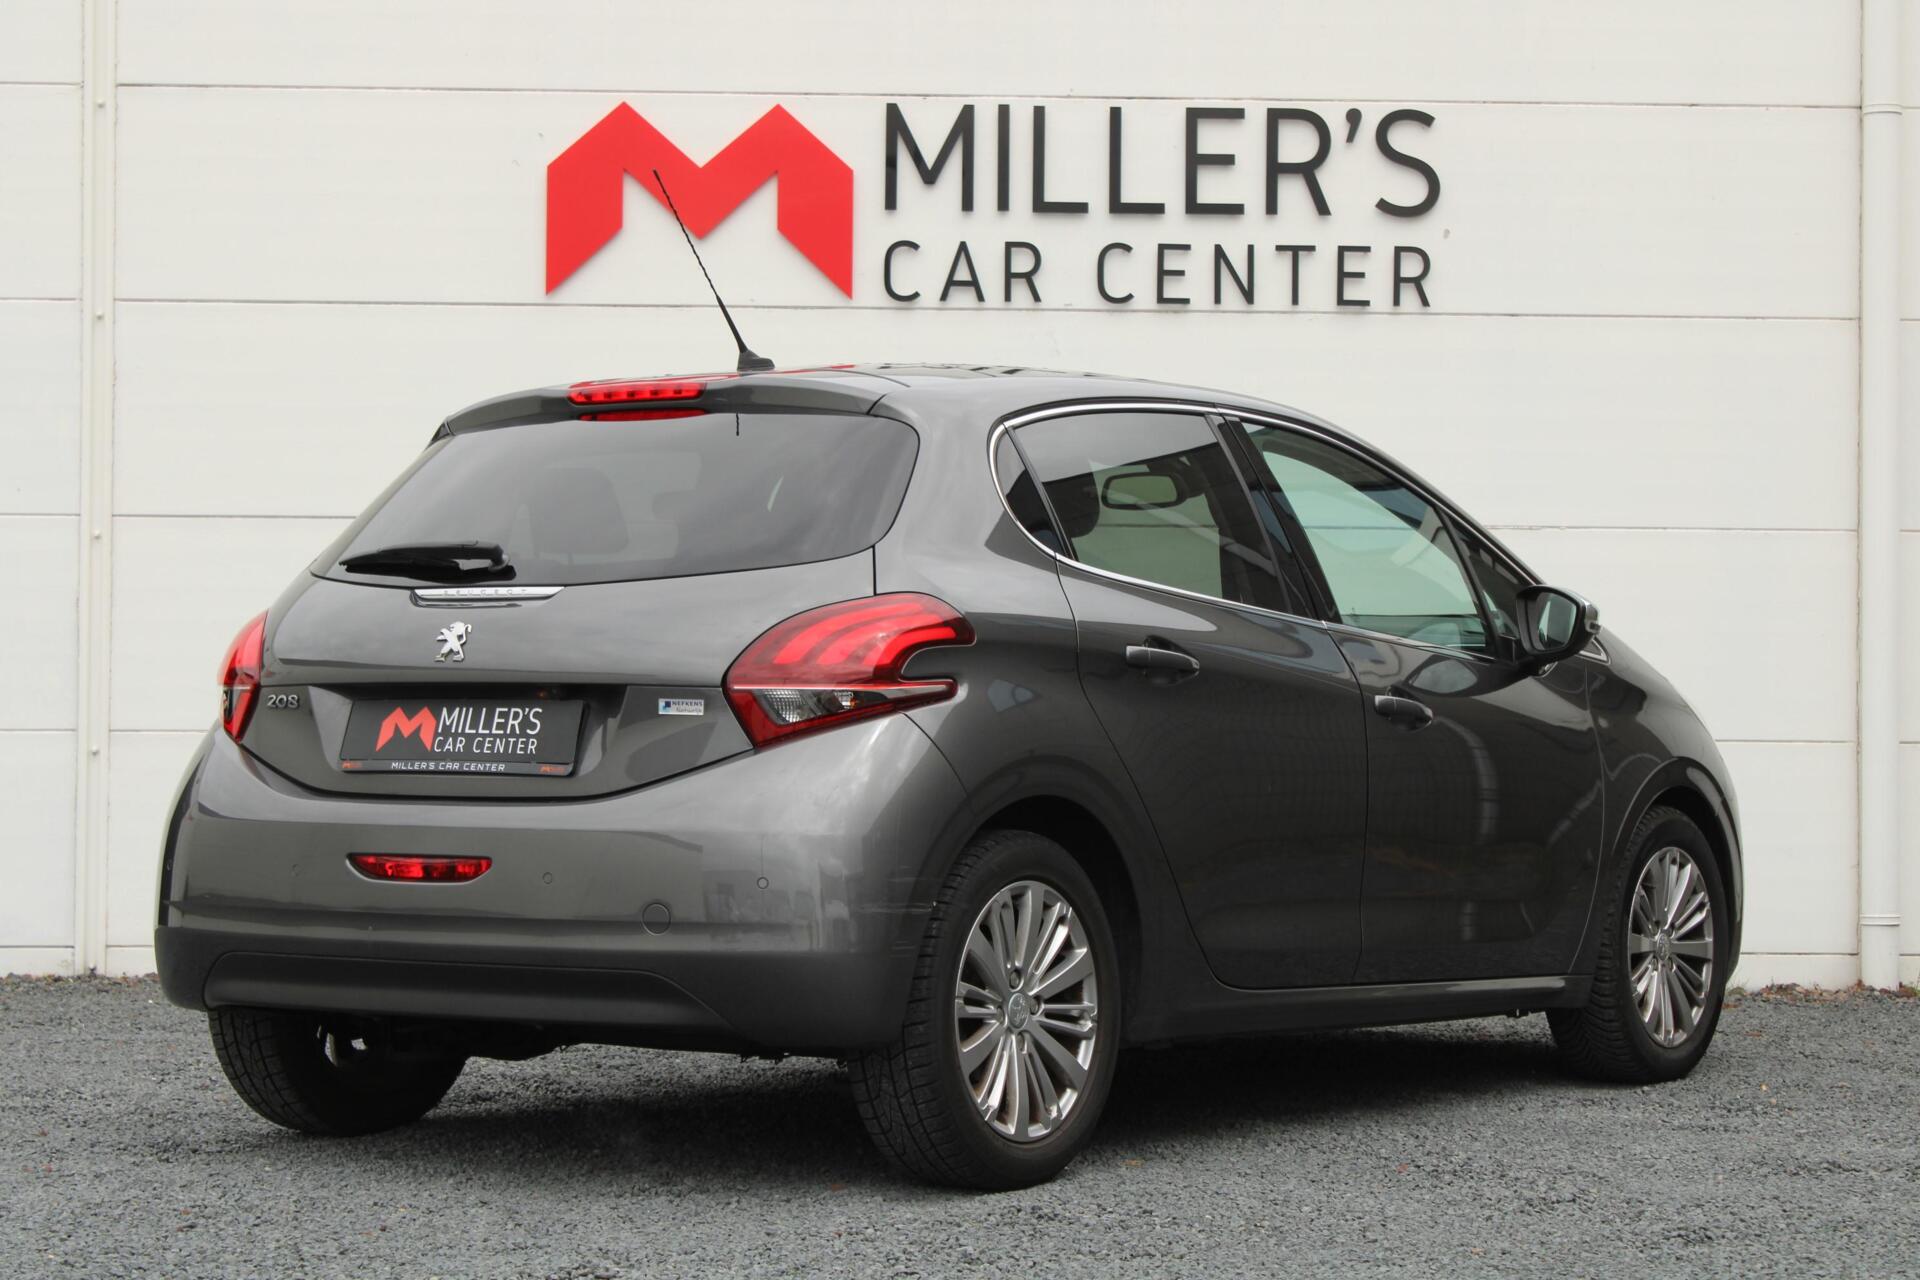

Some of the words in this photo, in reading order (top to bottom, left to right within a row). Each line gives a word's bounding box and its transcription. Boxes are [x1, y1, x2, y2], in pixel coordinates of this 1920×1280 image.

[884, 102, 1442, 218] MILLER'S
[883, 240, 1042, 304] CAR
[1097, 242, 1431, 308] CENTER
[267, 694, 298, 708] 208
[437, 707, 543, 735] MILLER'S
[433, 736, 466, 753] CAR
[472, 738, 538, 755] CENTER
[438, 762, 460, 771] CAR
[462, 762, 506, 772] CENTER
